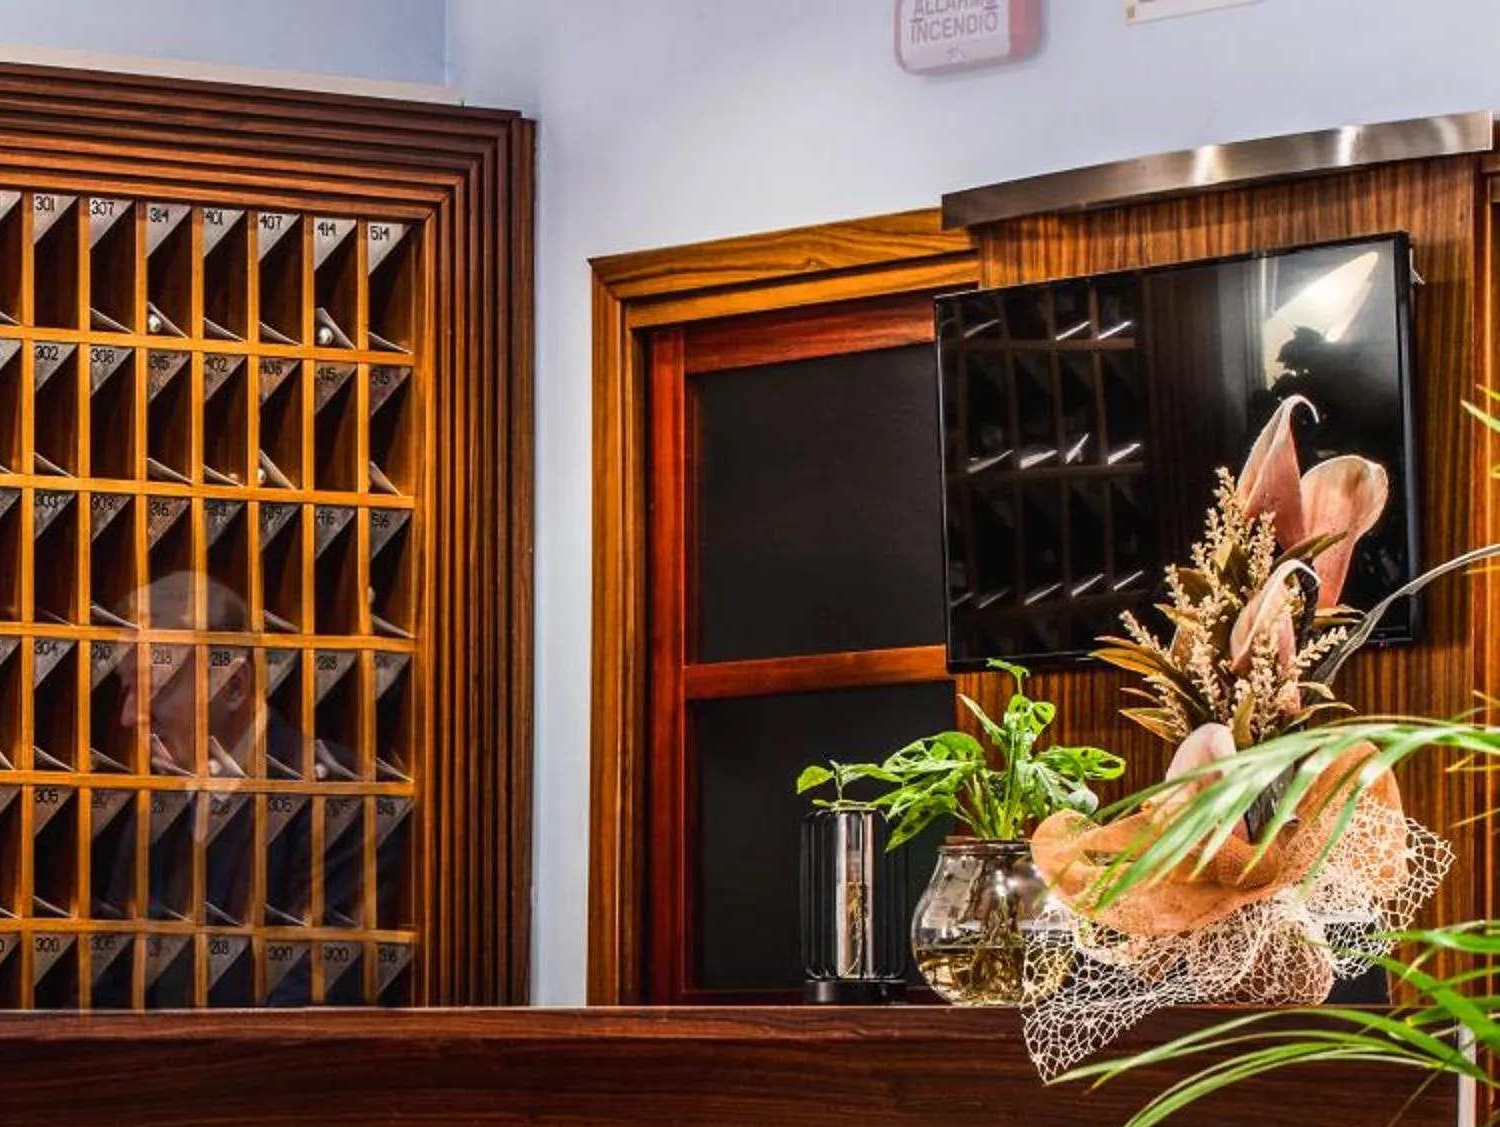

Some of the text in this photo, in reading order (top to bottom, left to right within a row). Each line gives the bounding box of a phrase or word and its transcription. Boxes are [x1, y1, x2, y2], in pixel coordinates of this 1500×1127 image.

[910, 11, 998, 44] INCENDIO
[36, 196, 55, 213] 301
[92, 200, 114, 217] 307
[260, 215, 282, 231] 407
[318, 222, 336, 238] 414
[371, 225, 389, 242] 514
[35, 345, 59, 362] 302
